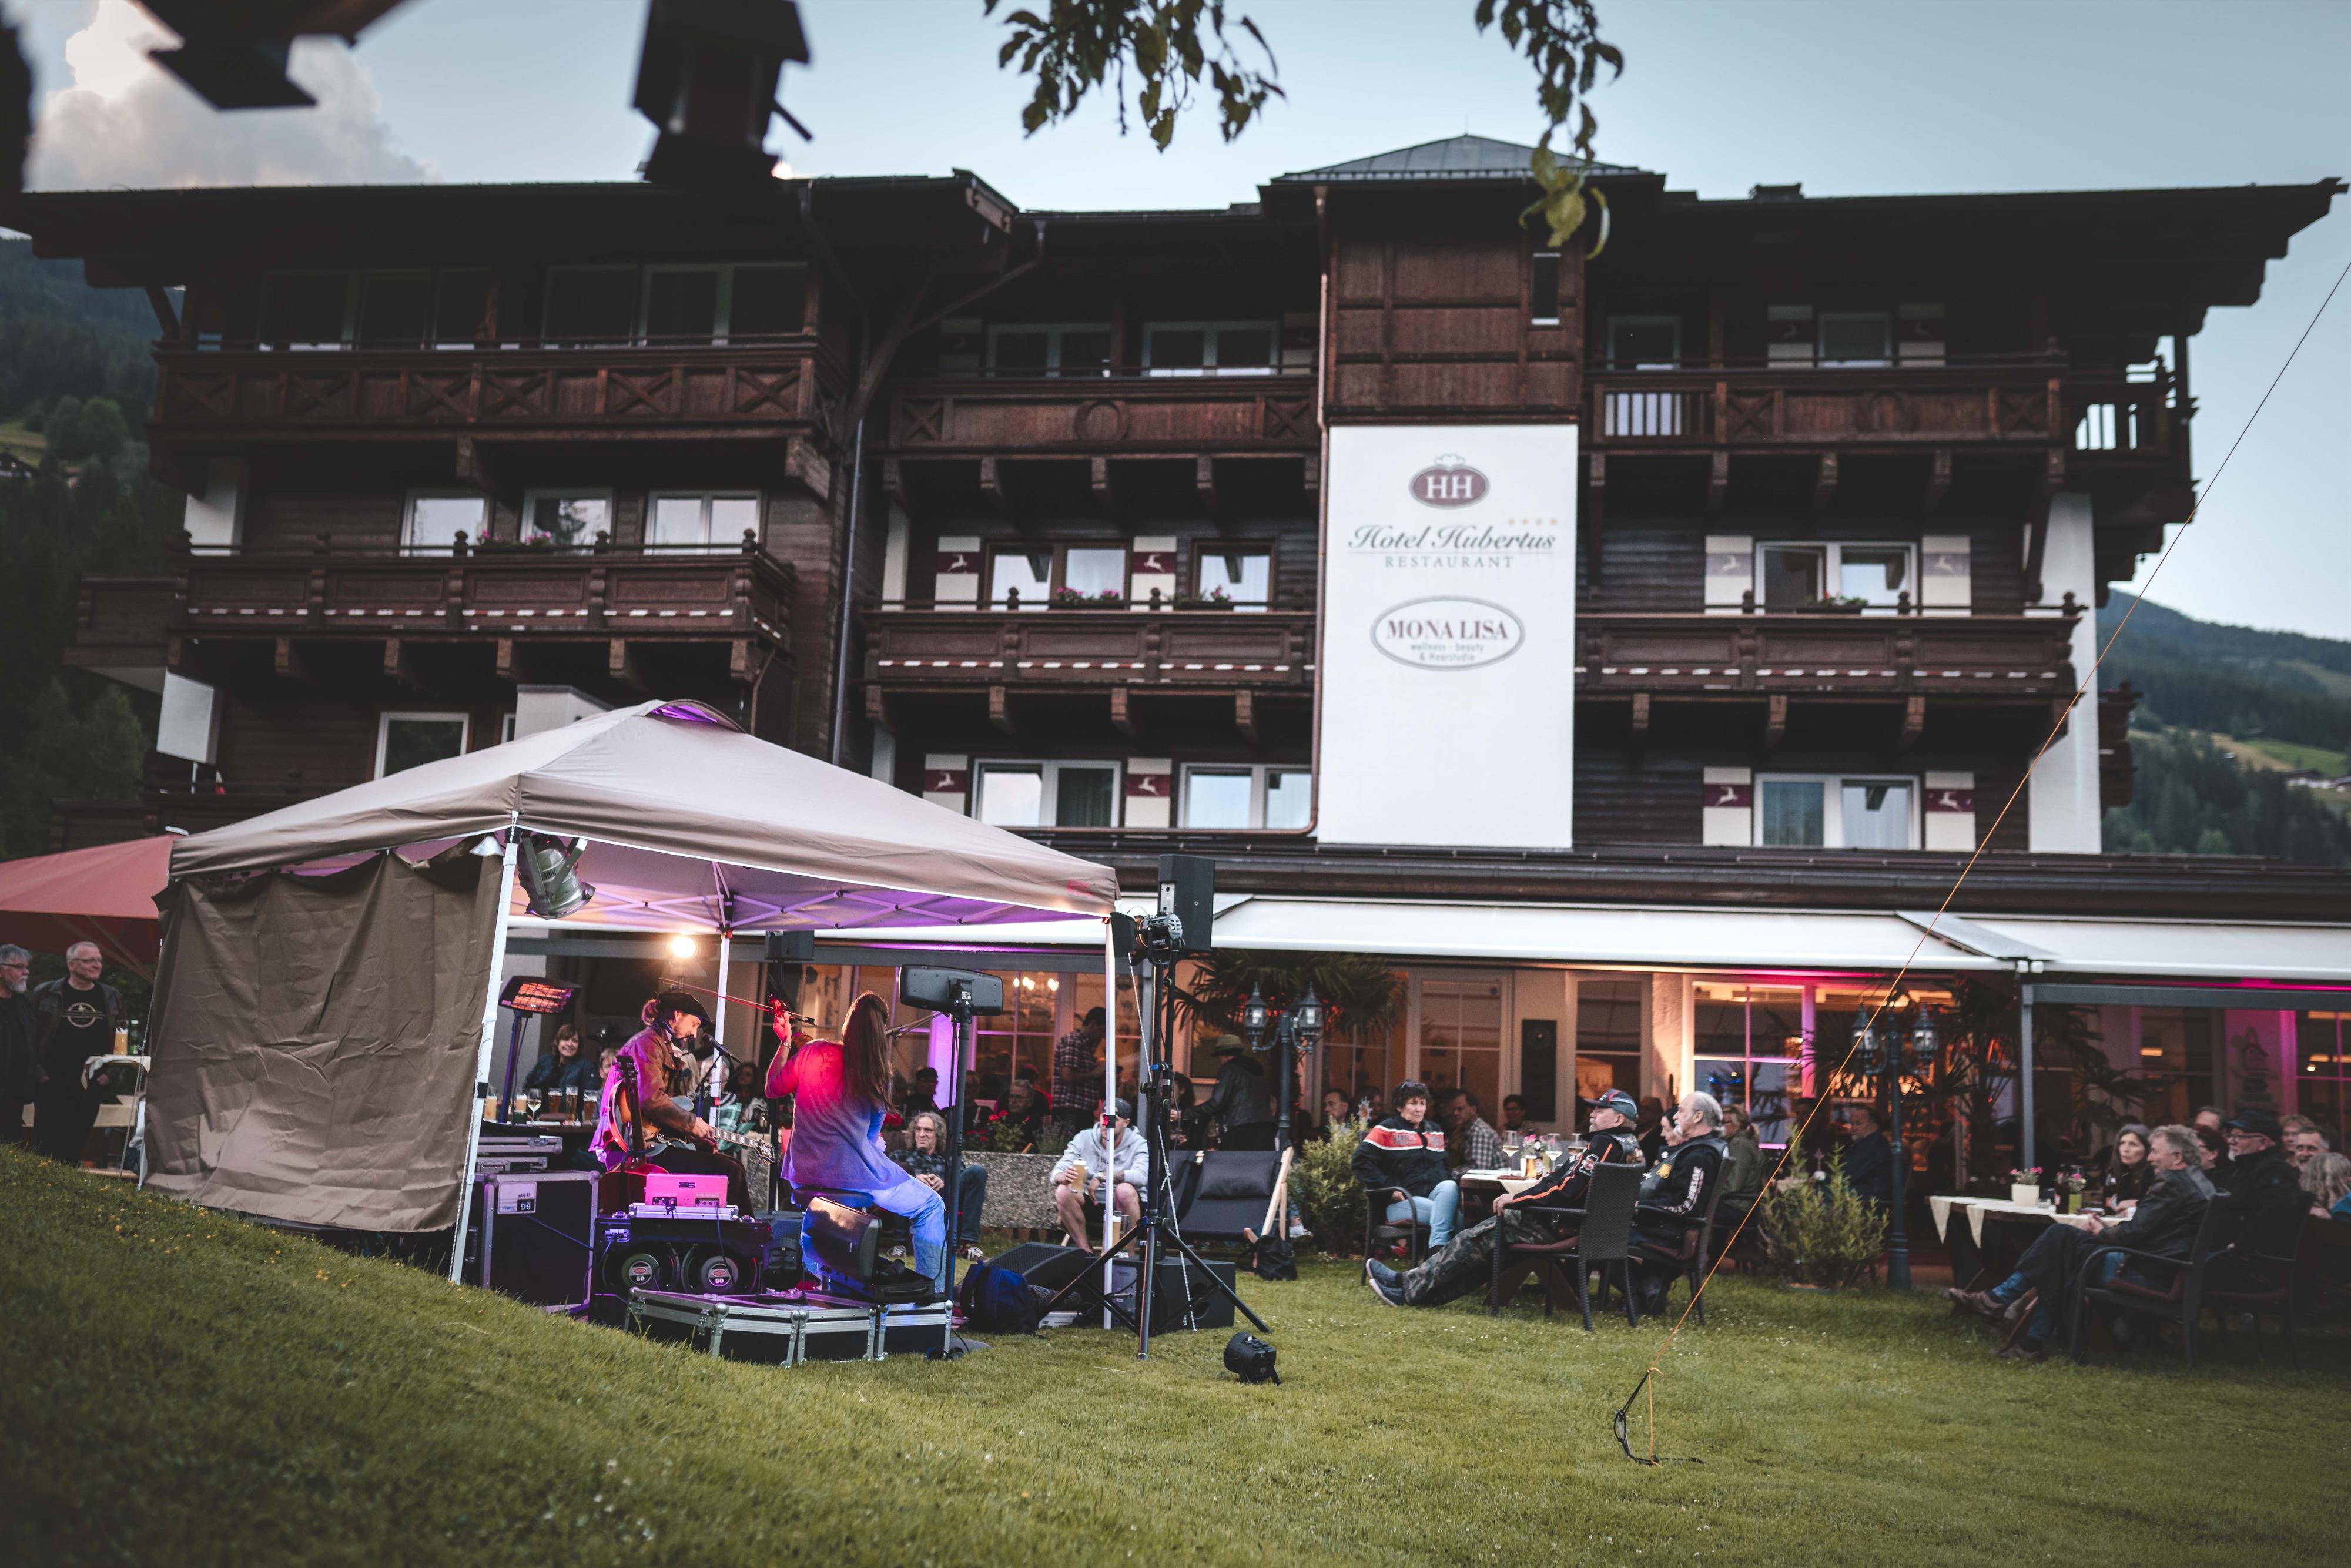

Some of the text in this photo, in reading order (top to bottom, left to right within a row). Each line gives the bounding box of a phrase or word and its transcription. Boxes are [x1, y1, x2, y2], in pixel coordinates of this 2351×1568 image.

[1425, 475, 1473, 499] HH
[1348, 525, 1556, 549] Hotel Hubertus
[1385, 556, 1514, 568] RESTAURANT
[1387, 620, 1509, 639] MONA LISA
[1411, 642, 1485, 652] wellness beauty
